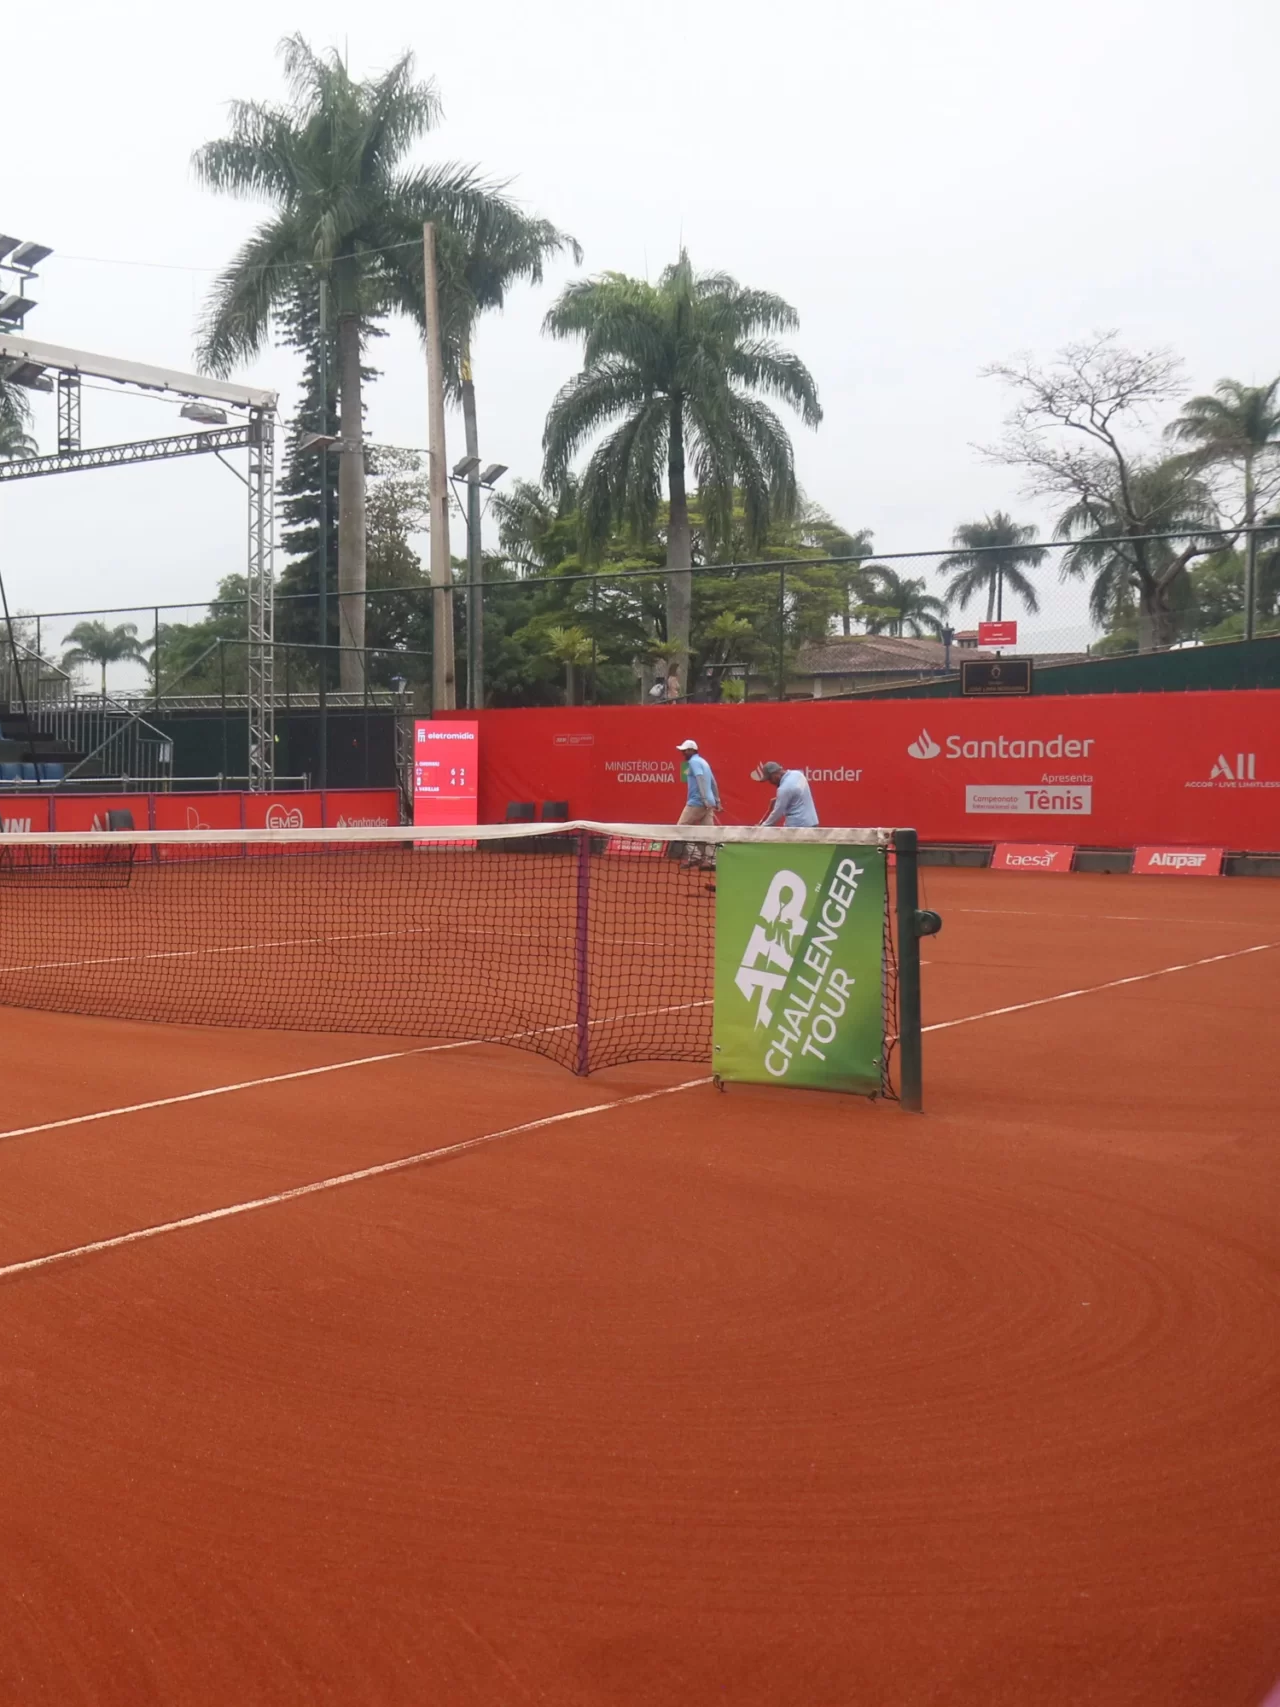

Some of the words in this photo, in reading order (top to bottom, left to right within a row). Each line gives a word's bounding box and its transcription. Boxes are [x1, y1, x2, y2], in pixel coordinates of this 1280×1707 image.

[946, 734, 1095, 759] Santander
[605, 759, 658, 771] MINISTÉRIO
[660, 761, 675, 771] DA
[450, 768, 456, 776] 6
[460, 768, 465, 776] 2
[617, 773, 675, 783] CIDADANIA
[805, 766, 863, 782] tander
[1041, 773, 1094, 784] Apresenta
[450, 778, 456, 786] 4
[973, 795, 1018, 804] Campeonato
[1024, 790, 1083, 810] Tênis
[269, 818, 300, 829] EMS
[347, 816, 389, 828] Santander
[1006, 853, 1051, 867] taesa
[1148, 852, 1207, 869] Alupar
[734, 869, 809, 1033] ATP
[764, 858, 865, 1077] CHALLENGER
[801, 968, 856, 1062] TOUR
